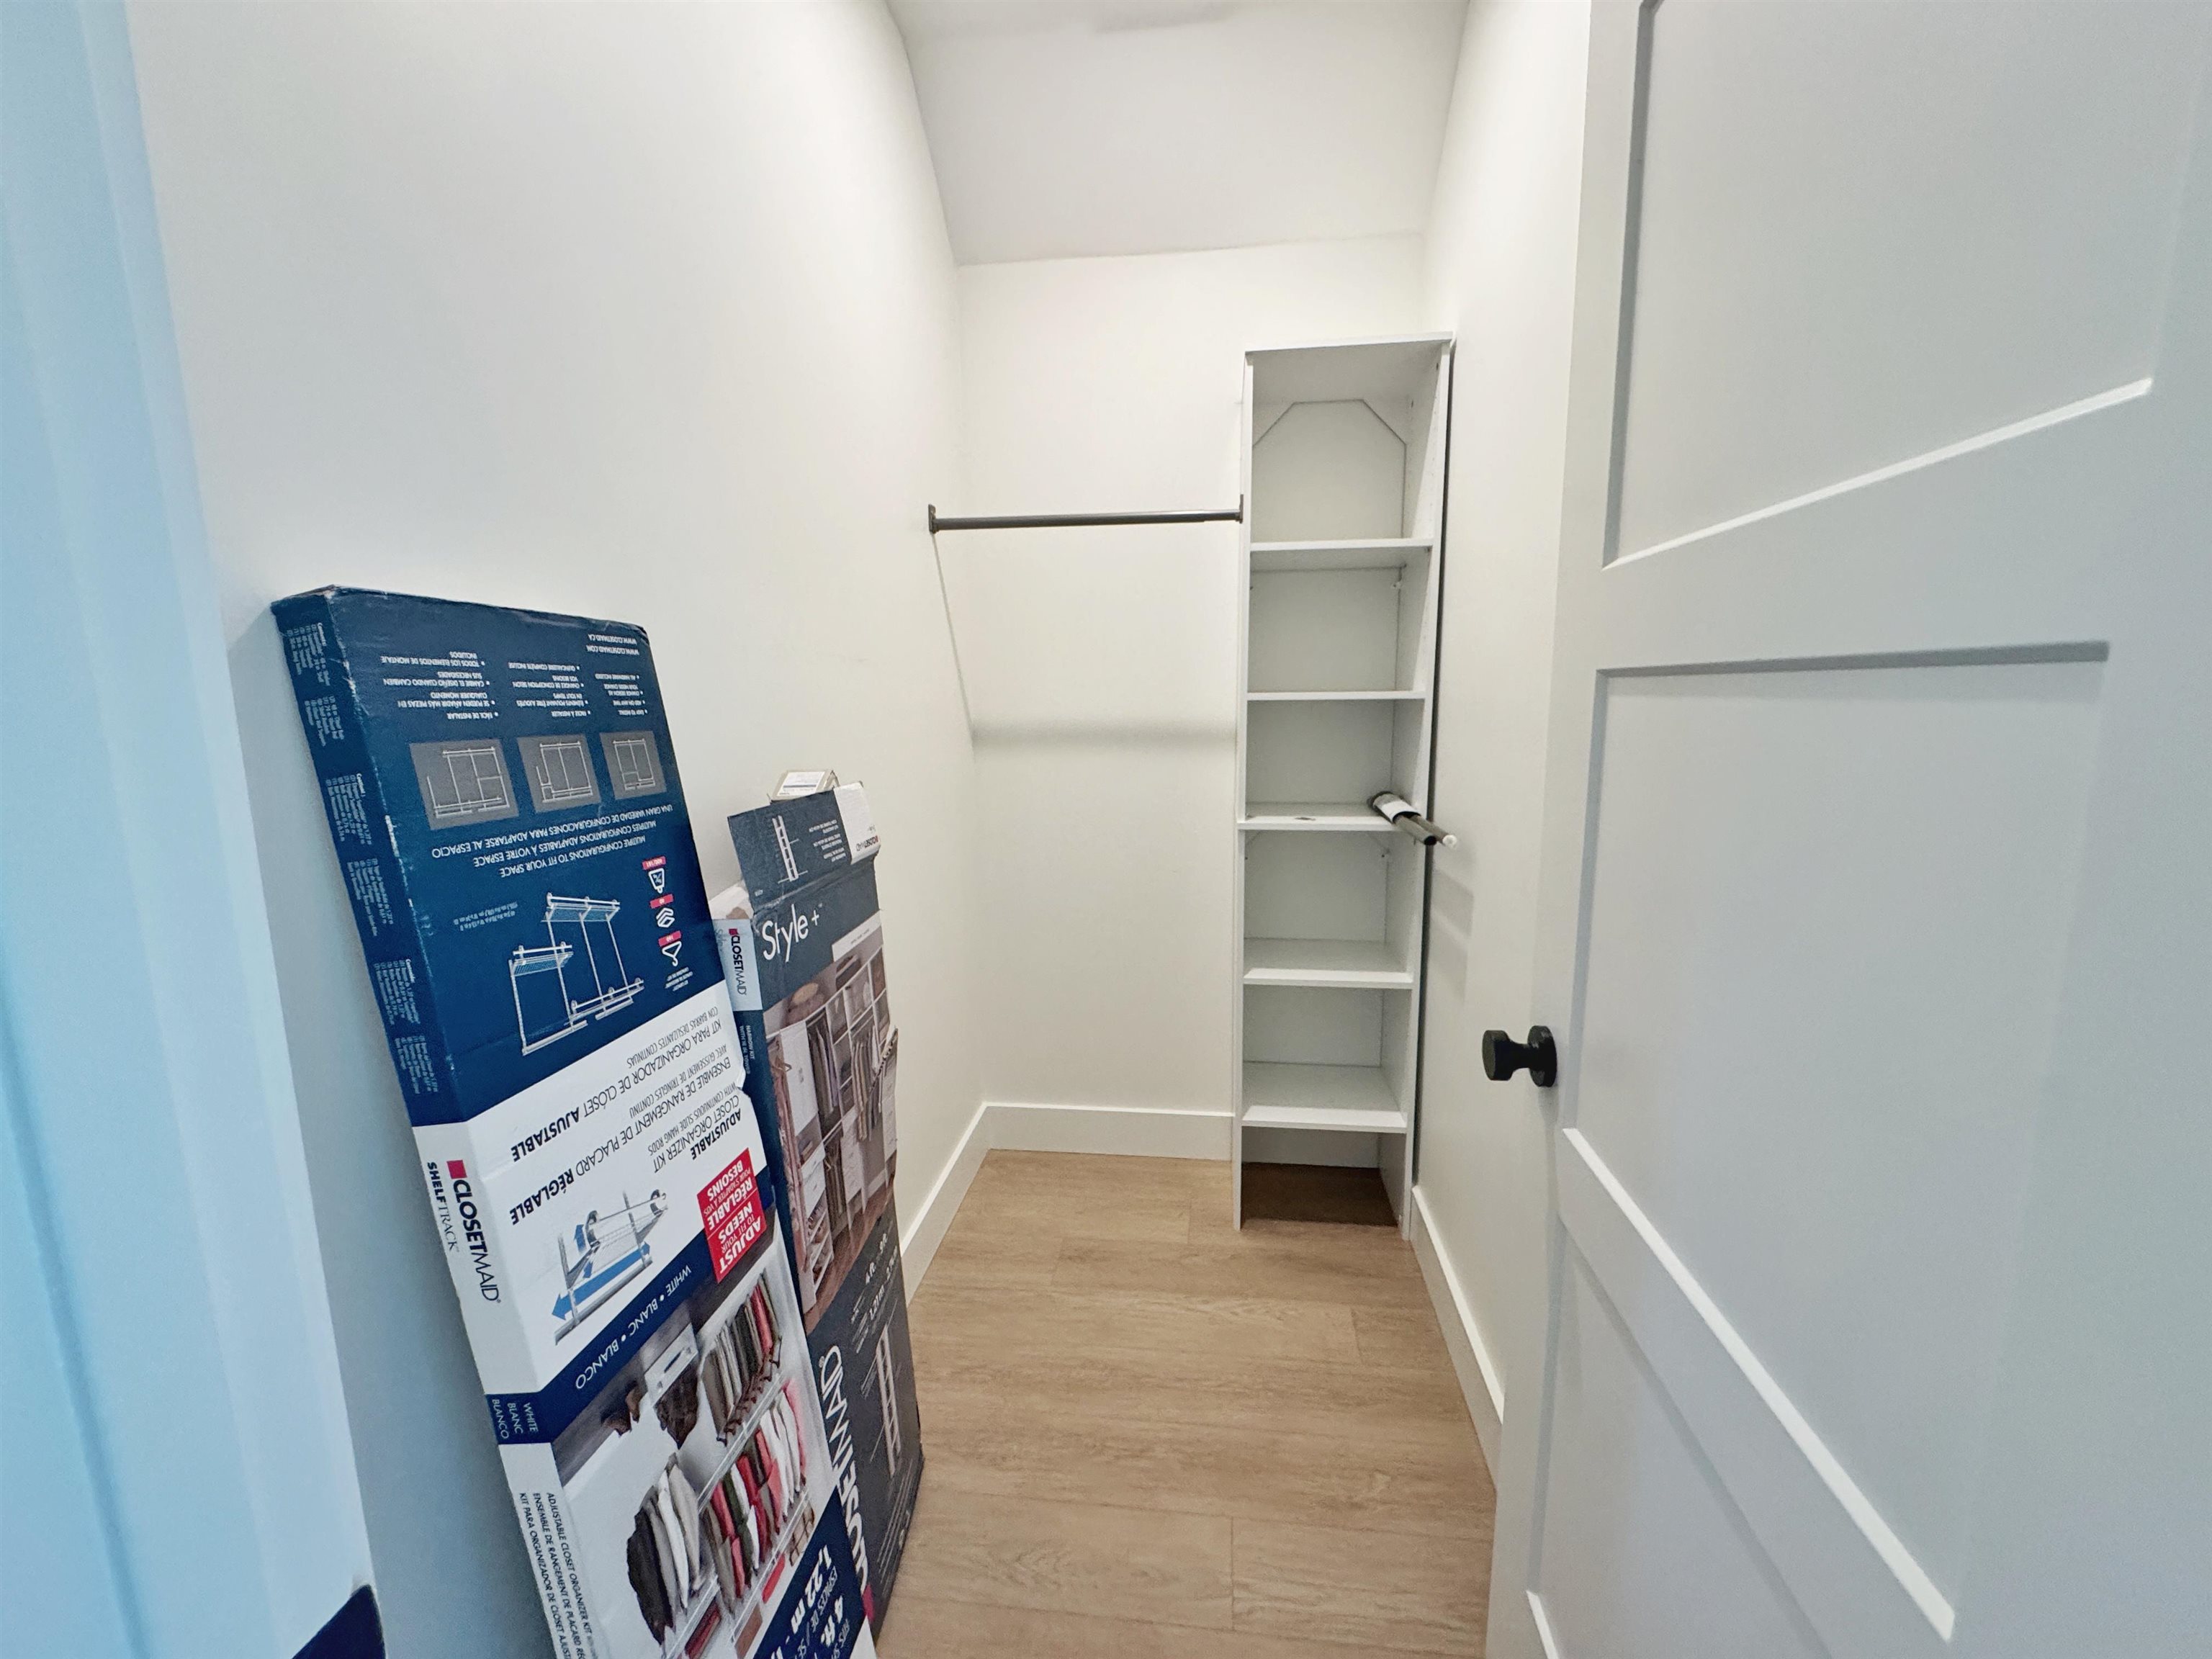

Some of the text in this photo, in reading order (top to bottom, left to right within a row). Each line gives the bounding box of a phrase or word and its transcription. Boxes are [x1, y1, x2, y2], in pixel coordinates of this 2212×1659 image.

[549, 817, 611, 835] CONFIGURACIONES
[611, 814, 619, 823] DE
[620, 810, 645, 821] VARIEDAD
[645, 806, 661, 816] GRAN
[432, 842, 471, 858] ESPACIO
[472, 840, 482, 850] AL
[473, 821, 656, 866] MULTIPLES CONFIGURATIONS ADAPTABLES À VOTRE ESPACE
[485, 832, 527, 848] ADAPTARSE
[529, 828, 548, 838] PARA
[500, 836, 645, 877] MULTIPLE CONFIGURATIONS TO FIT YOUR SPACE
[626, 1007, 718, 1068] CON BARRAS DESLIZANTES CONTINUAS
[511, 1019, 721, 1161] KIT PARA ORGANIZADOR DE CLÓSET AJUSTABLE
[629, 1044, 727, 1118] AVEC GLISSEMENT DE TRINGLES CONTINU
[648, 1082, 737, 1155] WITH CONTINUOUS SLIDE HANG RODS
[654, 1095, 739, 1172] CLOSET ORGANIZER KIT
[691, 1110, 740, 1159] ADJUSTABLE
[511, 1057, 730, 1224] ENSEMBLE DE RANGEMENT DE PLACARD RÉGLABLE
[708, 1161, 742, 1200] BESOINS
[708, 1178, 752, 1229] RÉGLABLE
[719, 1202, 752, 1243] NEEDS
[720, 1218, 760, 1272] ADJUST
[721, 1214, 755, 1253] TO FIT YOUR
[576, 1266, 691, 1388] WHITE BLANC BLANCO
[493, 1398, 509, 1439] BLANCO
[508, 1402, 523, 1434] BLANC
[524, 1402, 538, 1433] WHITE
[520, 1493, 529, 1504] KIT
[523, 1507, 534, 1528] PARA
[534, 1493, 550, 1532] ENSEMBLE
[544, 1534, 554, 1545] DE
[530, 1531, 552, 1590] ORGANIZADOR
[547, 1493, 566, 1539] ADJUSTABLE
[561, 1542, 575, 1570] CLOSET
[570, 1573, 588, 1619] ORGANIZER
[583, 1622, 592, 1633] KIT
[549, 1547, 568, 1596] RANGEMENT
[805, 1545, 832, 1608] 1,22
[547, 1593, 555, 1602] DE
[562, 1599, 571, 1608] DE
[818, 1566, 837, 1616] ESPACES
[835, 1595, 842, 1624] 4
[551, 1605, 564, 1632] CLÓSET
[566, 1611, 581, 1645] PLACARD
[791, 1598, 805, 1635] m
[811, 1609, 819, 1633] DE
